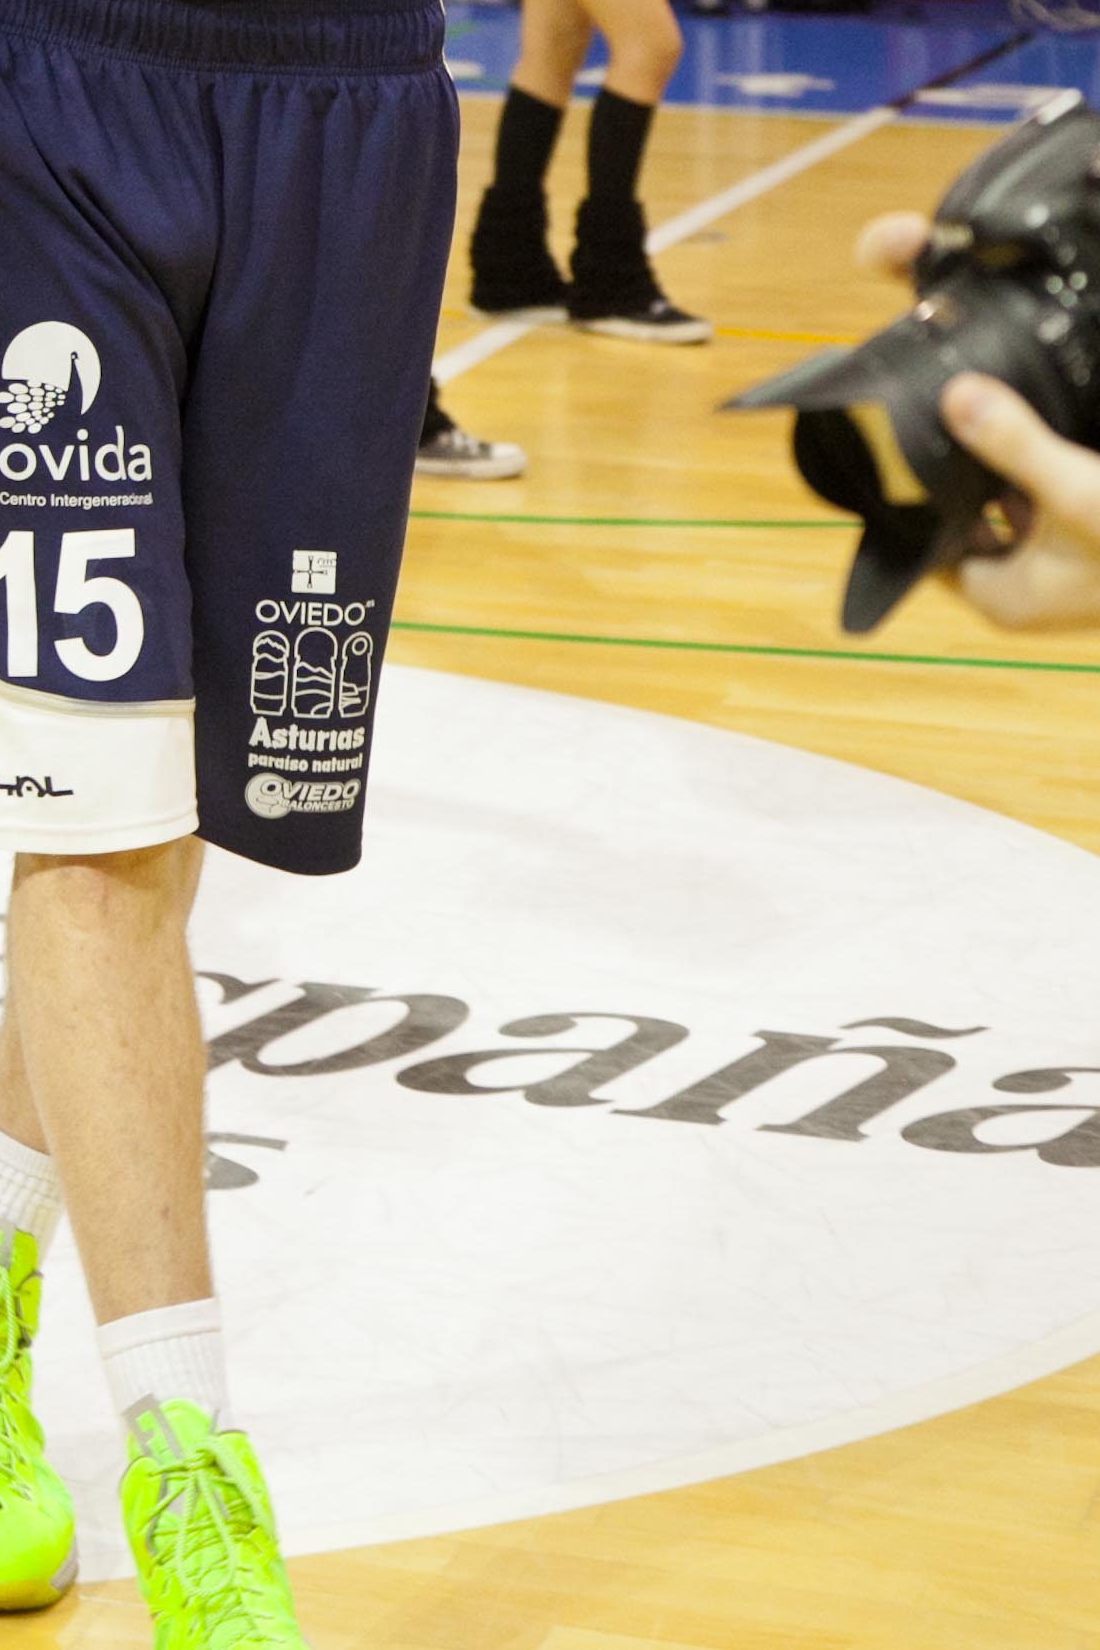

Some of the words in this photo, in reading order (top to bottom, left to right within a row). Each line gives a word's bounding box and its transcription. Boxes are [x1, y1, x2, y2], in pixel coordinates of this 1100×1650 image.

[248, 716, 366, 752] Asturias
[311, 752, 363, 774] natural
[260, 779, 361, 801] OVIEDO
